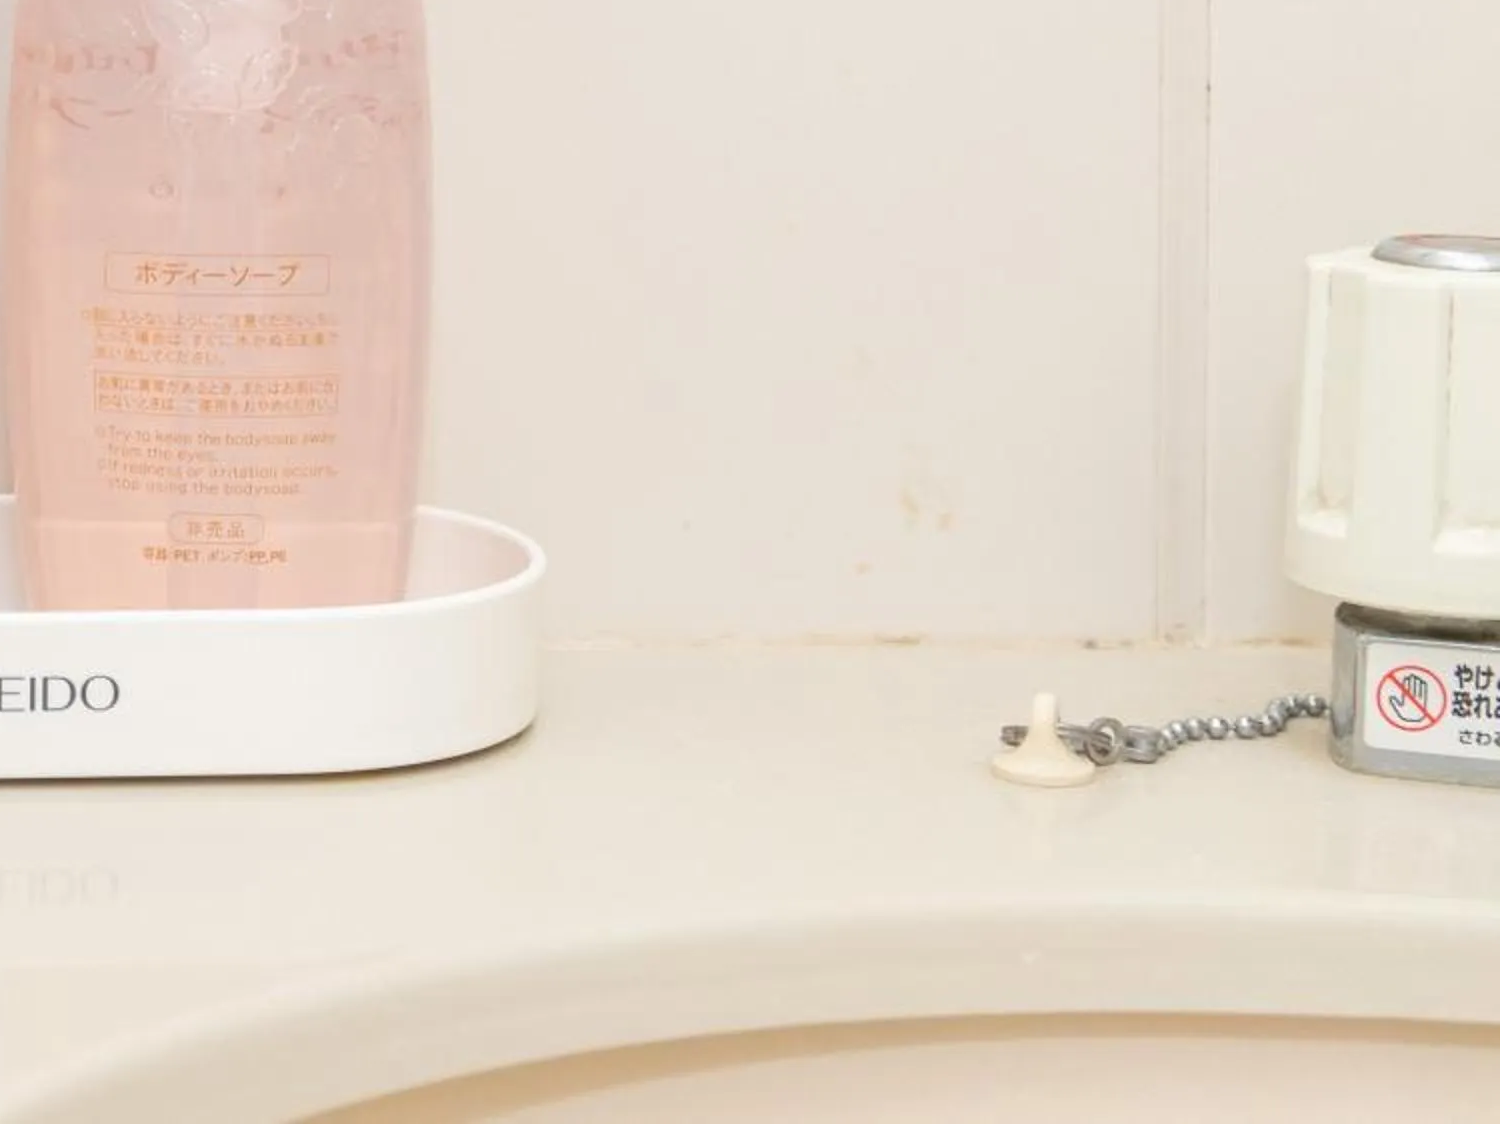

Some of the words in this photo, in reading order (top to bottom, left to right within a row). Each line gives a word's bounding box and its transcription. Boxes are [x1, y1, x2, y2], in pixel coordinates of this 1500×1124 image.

[108, 424, 130, 444] Try
[137, 429, 151, 443] to
[155, 429, 193, 447] keep
[197, 430, 221, 446] the
[108, 443, 142, 458] from
[147, 445, 171, 460] the
[145, 479, 188, 496] using
[192, 479, 219, 495] the
[186, 521, 246, 539] 非売品
[1454, 663, 1500, 690] やけ
[1452, 691, 1500, 718] 恐れ
